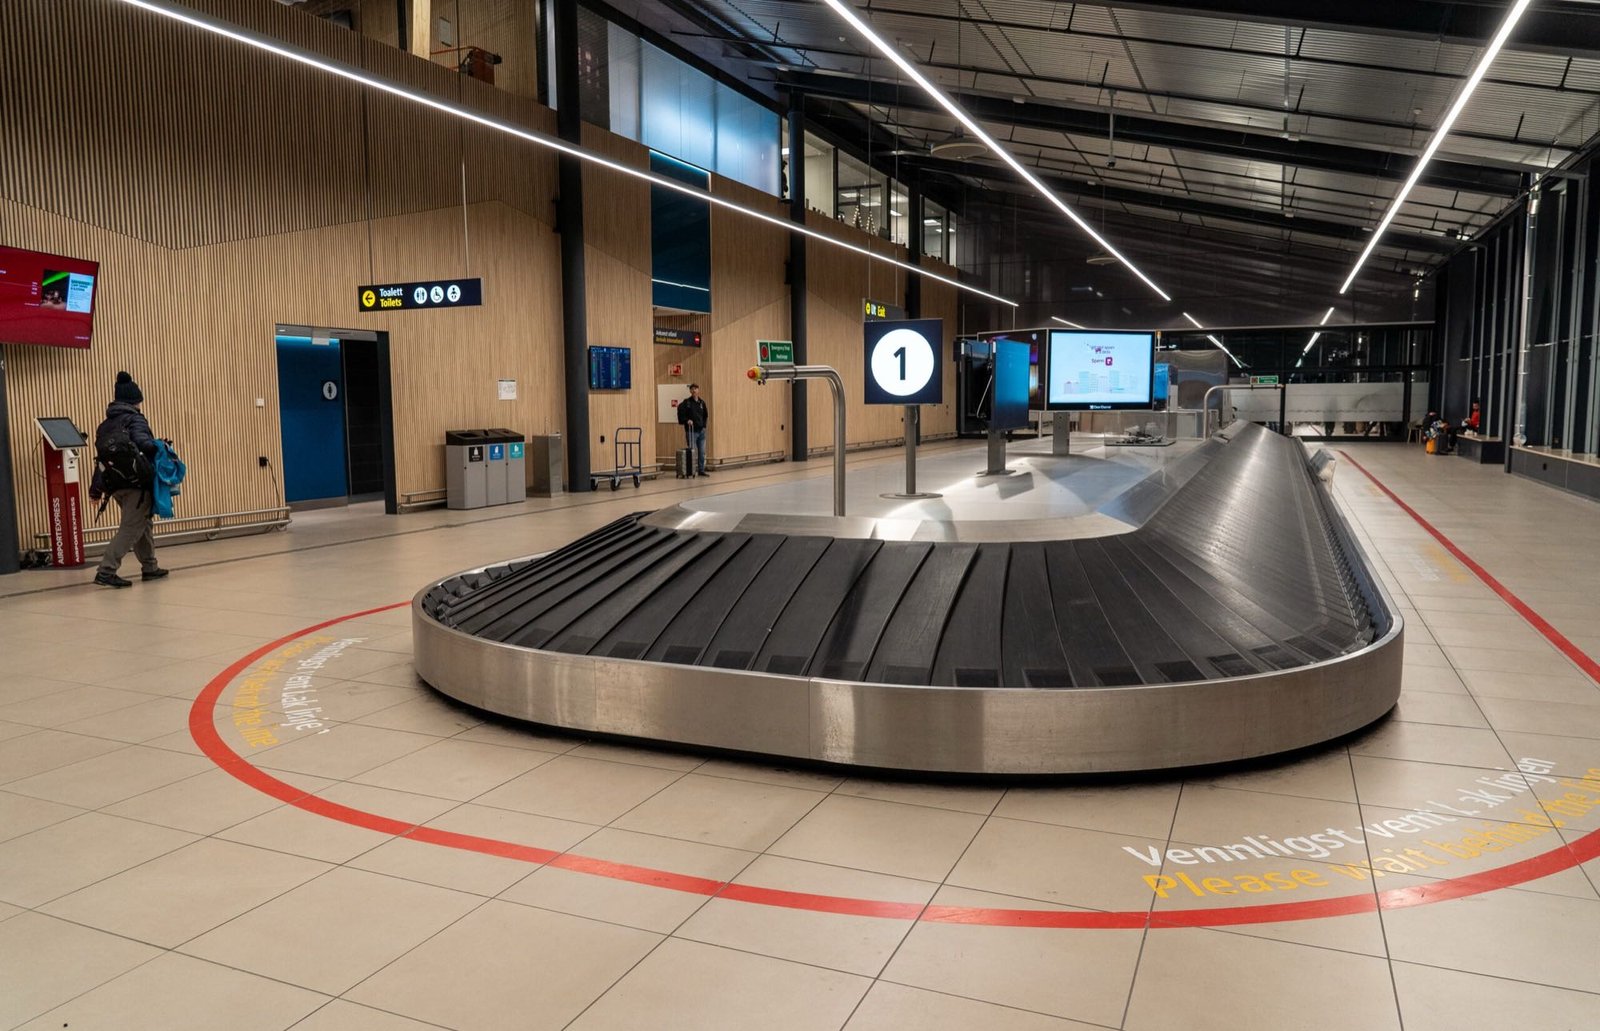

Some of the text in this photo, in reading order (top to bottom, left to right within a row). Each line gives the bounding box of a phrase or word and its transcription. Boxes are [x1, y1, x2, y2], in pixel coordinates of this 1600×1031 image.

[380, 287, 403, 298] Toalett
[380, 298, 402, 308] Toilets
[894, 346, 906, 380] 1
[52, 497, 64, 565] AIRPORTEXPRESS
[1122, 827, 1364, 867] Vennligst
[1357, 806, 1459, 839] vent
[1476, 756, 1557, 793] linjen
[1142, 869, 1329, 899] Please
[1327, 846, 1449, 882] wait
